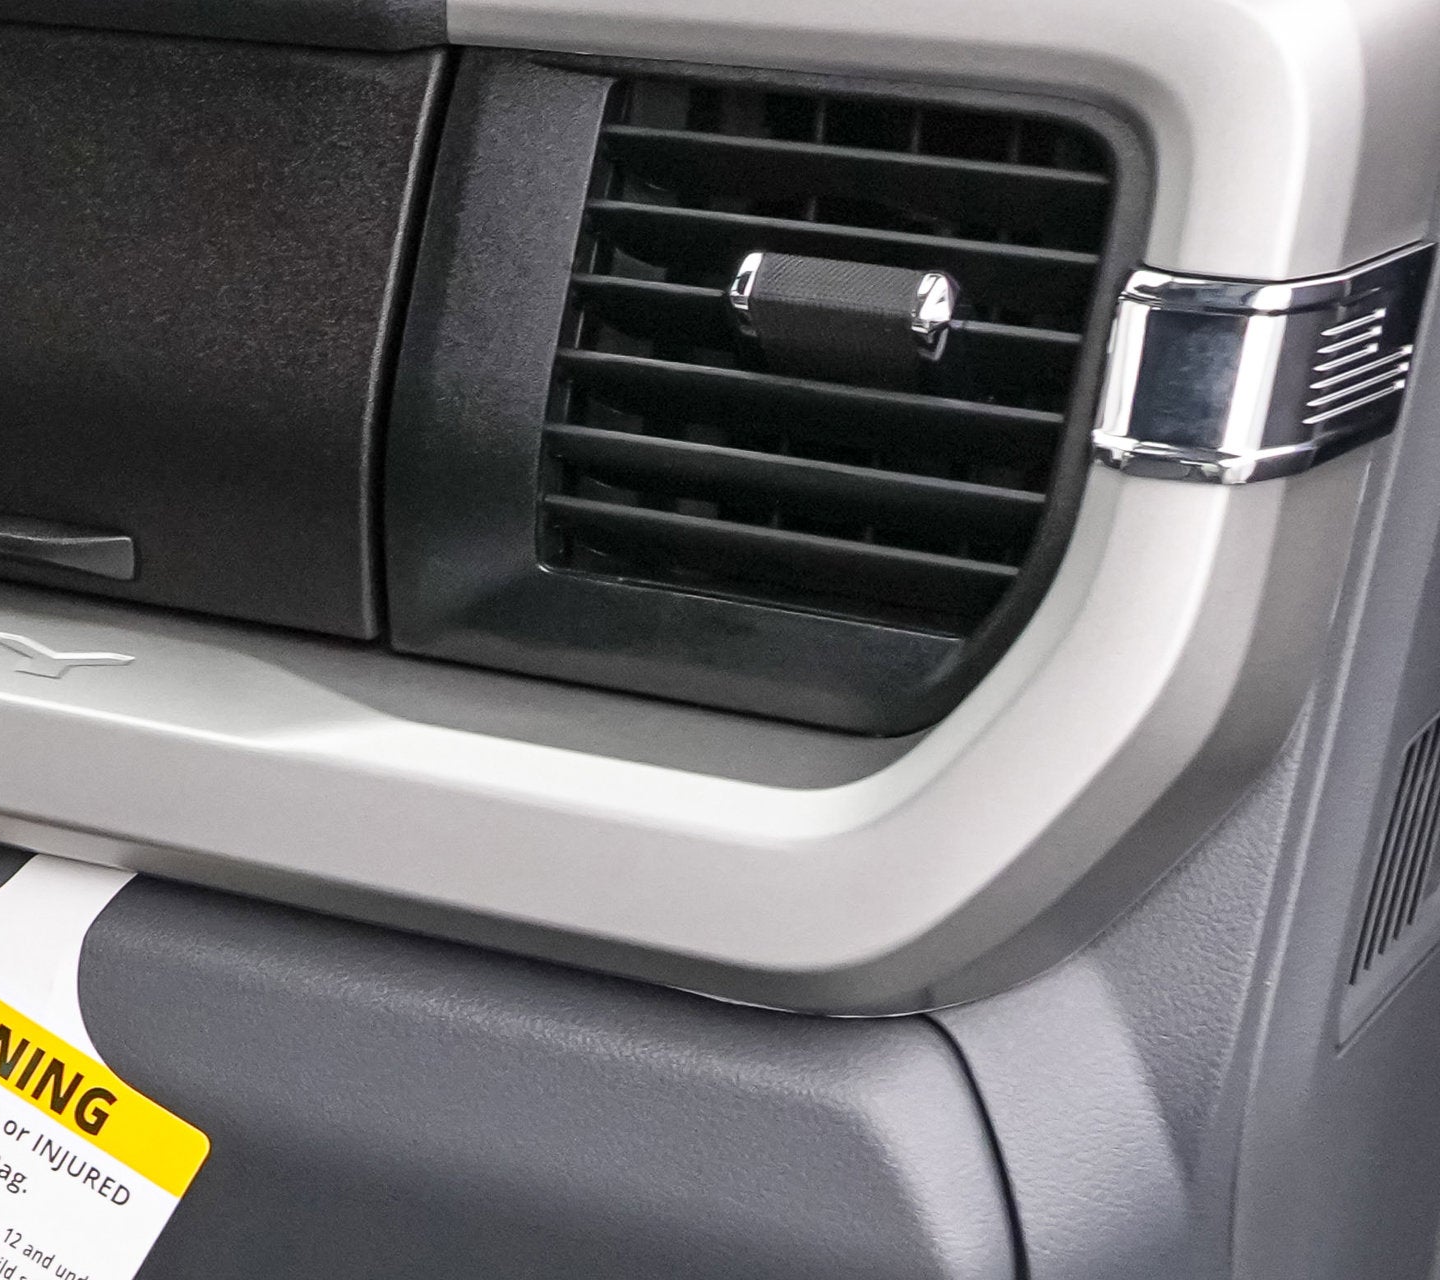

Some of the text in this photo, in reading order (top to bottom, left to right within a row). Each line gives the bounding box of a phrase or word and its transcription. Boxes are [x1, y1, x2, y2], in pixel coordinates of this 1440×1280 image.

[3, 1119, 31, 1142] or
[31, 1134, 131, 1207] INJURED
[3, 1228, 23, 1250] 12
[22, 1244, 57, 1270] and
